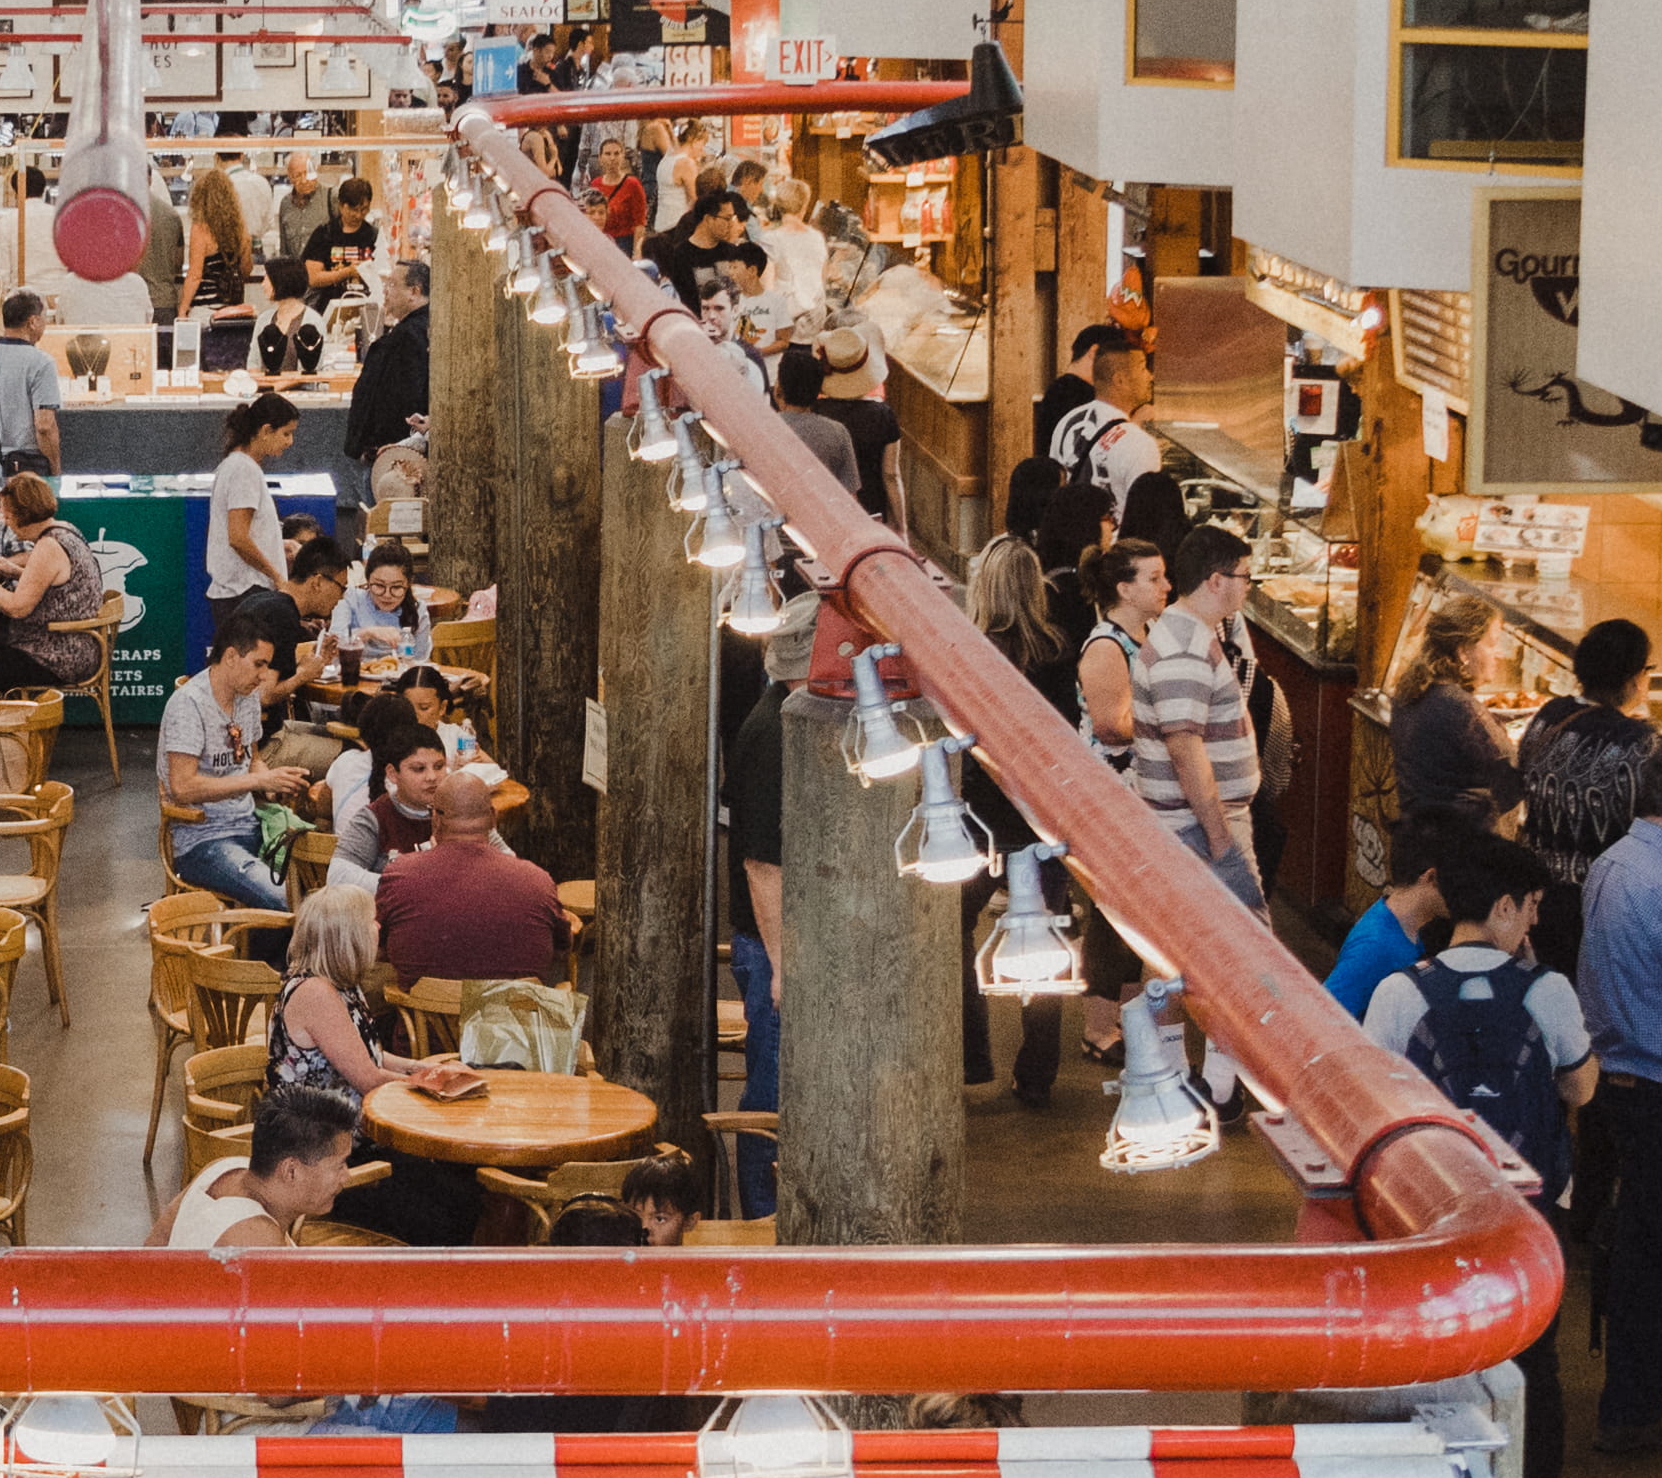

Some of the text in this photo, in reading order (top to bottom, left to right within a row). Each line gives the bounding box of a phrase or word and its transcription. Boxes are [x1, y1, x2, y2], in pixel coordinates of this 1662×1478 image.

[779, 40, 825, 74] EXIT
[1495, 248, 1579, 284] Gour
[110, 649, 162, 661] CRAPS
